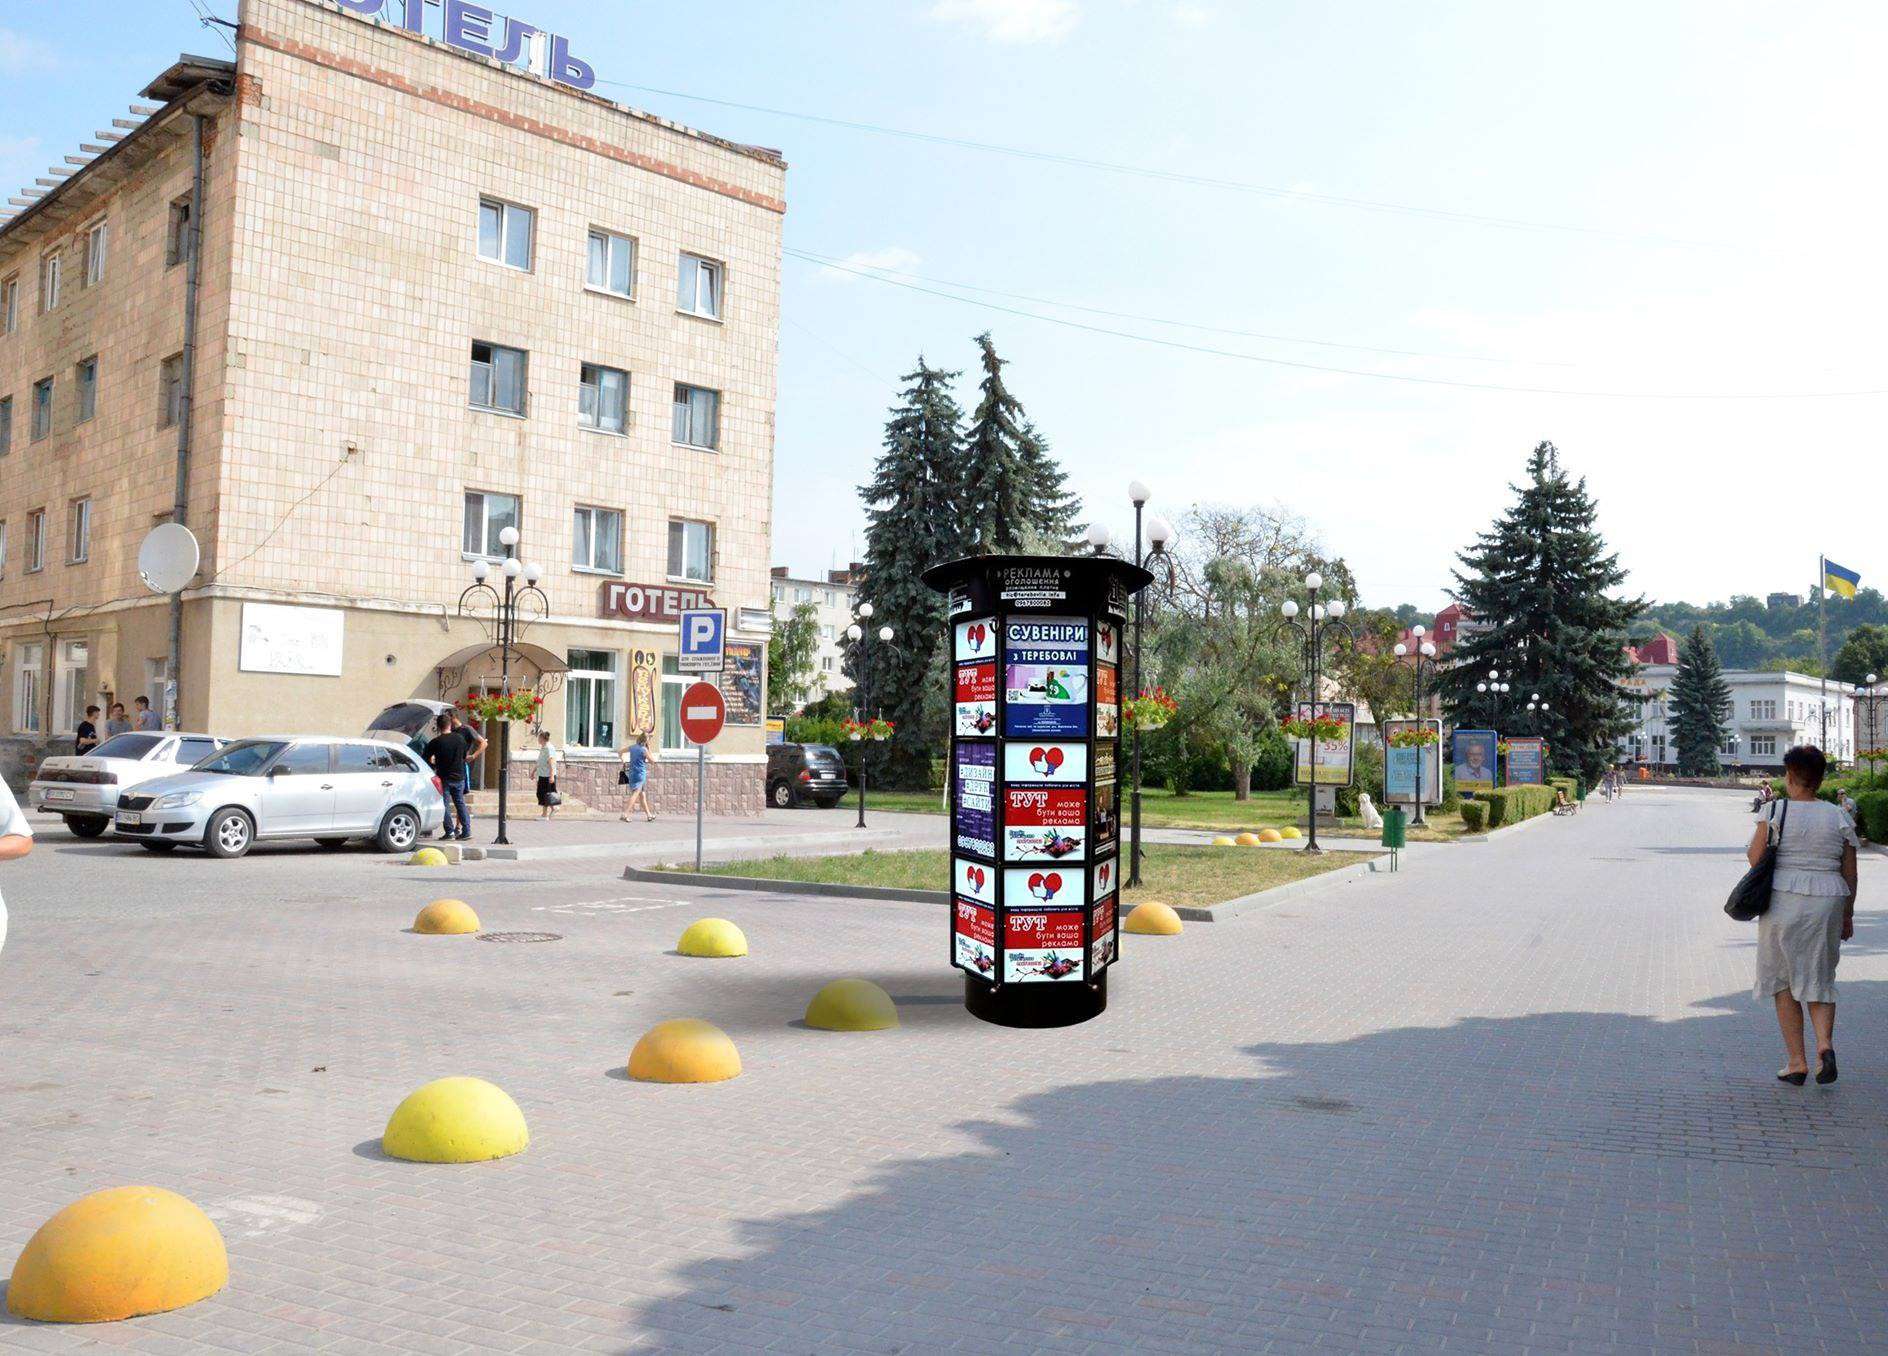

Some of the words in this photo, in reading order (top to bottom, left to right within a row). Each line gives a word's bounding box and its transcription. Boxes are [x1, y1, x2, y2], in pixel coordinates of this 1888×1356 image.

[1003, 567, 1060, 578] РЕКЛАМА
[690, 616, 715, 651] P
[1008, 624, 1085, 641] СУВЕНІРИ
[1022, 651, 1077, 661] ТЕРЕБОВЛІ
[1010, 791, 1048, 808] ТУТ
[1036, 808, 1056, 817] бути
[1058, 809, 1081, 817] ваша
[1009, 915, 1048, 932] ТУТ
[1036, 931, 1055, 940] бути
[1042, 940, 1079, 948] реклама
